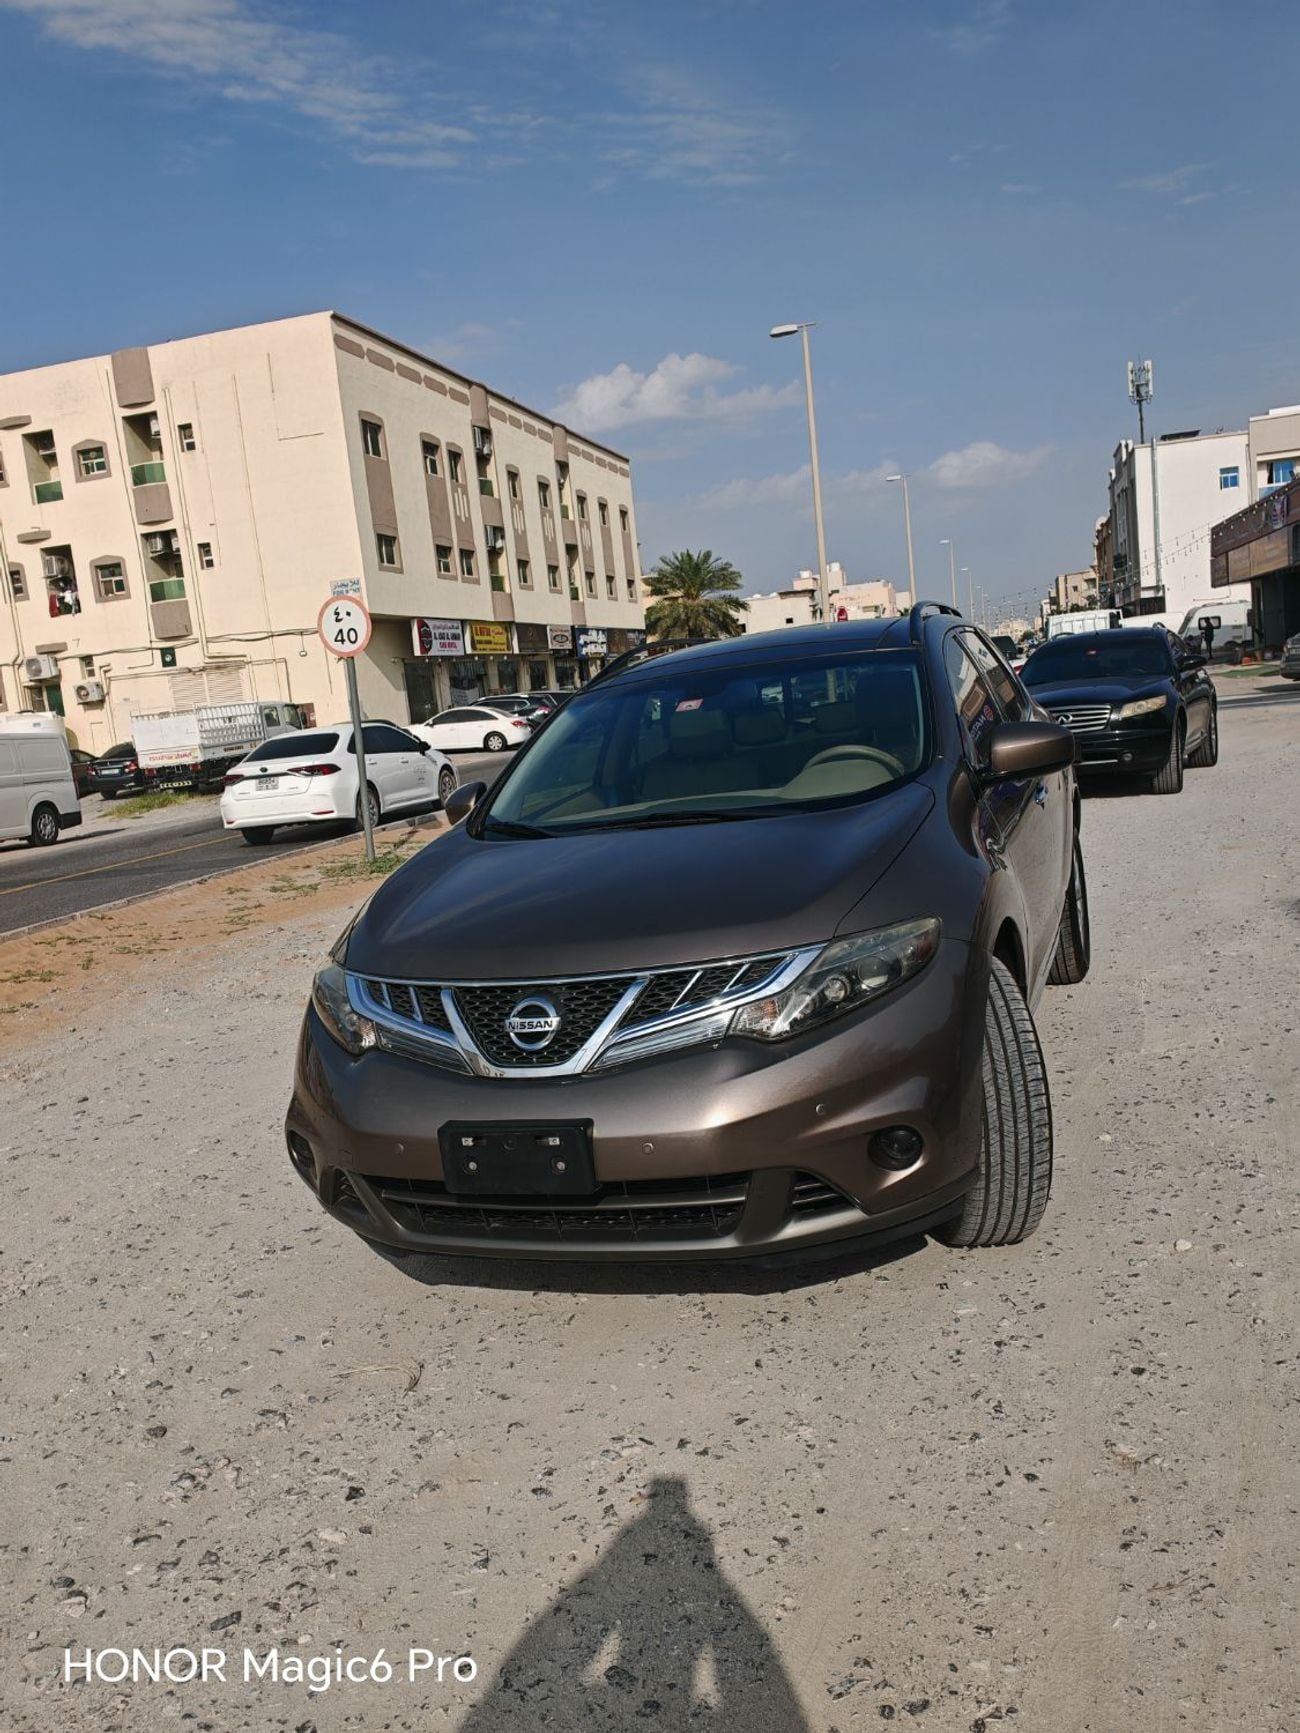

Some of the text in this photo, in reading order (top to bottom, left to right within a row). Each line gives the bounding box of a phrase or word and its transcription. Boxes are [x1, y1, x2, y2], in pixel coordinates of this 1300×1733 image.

[333, 606, 351, 623] ٤٠
[334, 628, 358, 645] 40
[508, 1020, 553, 1030] NISSAN
